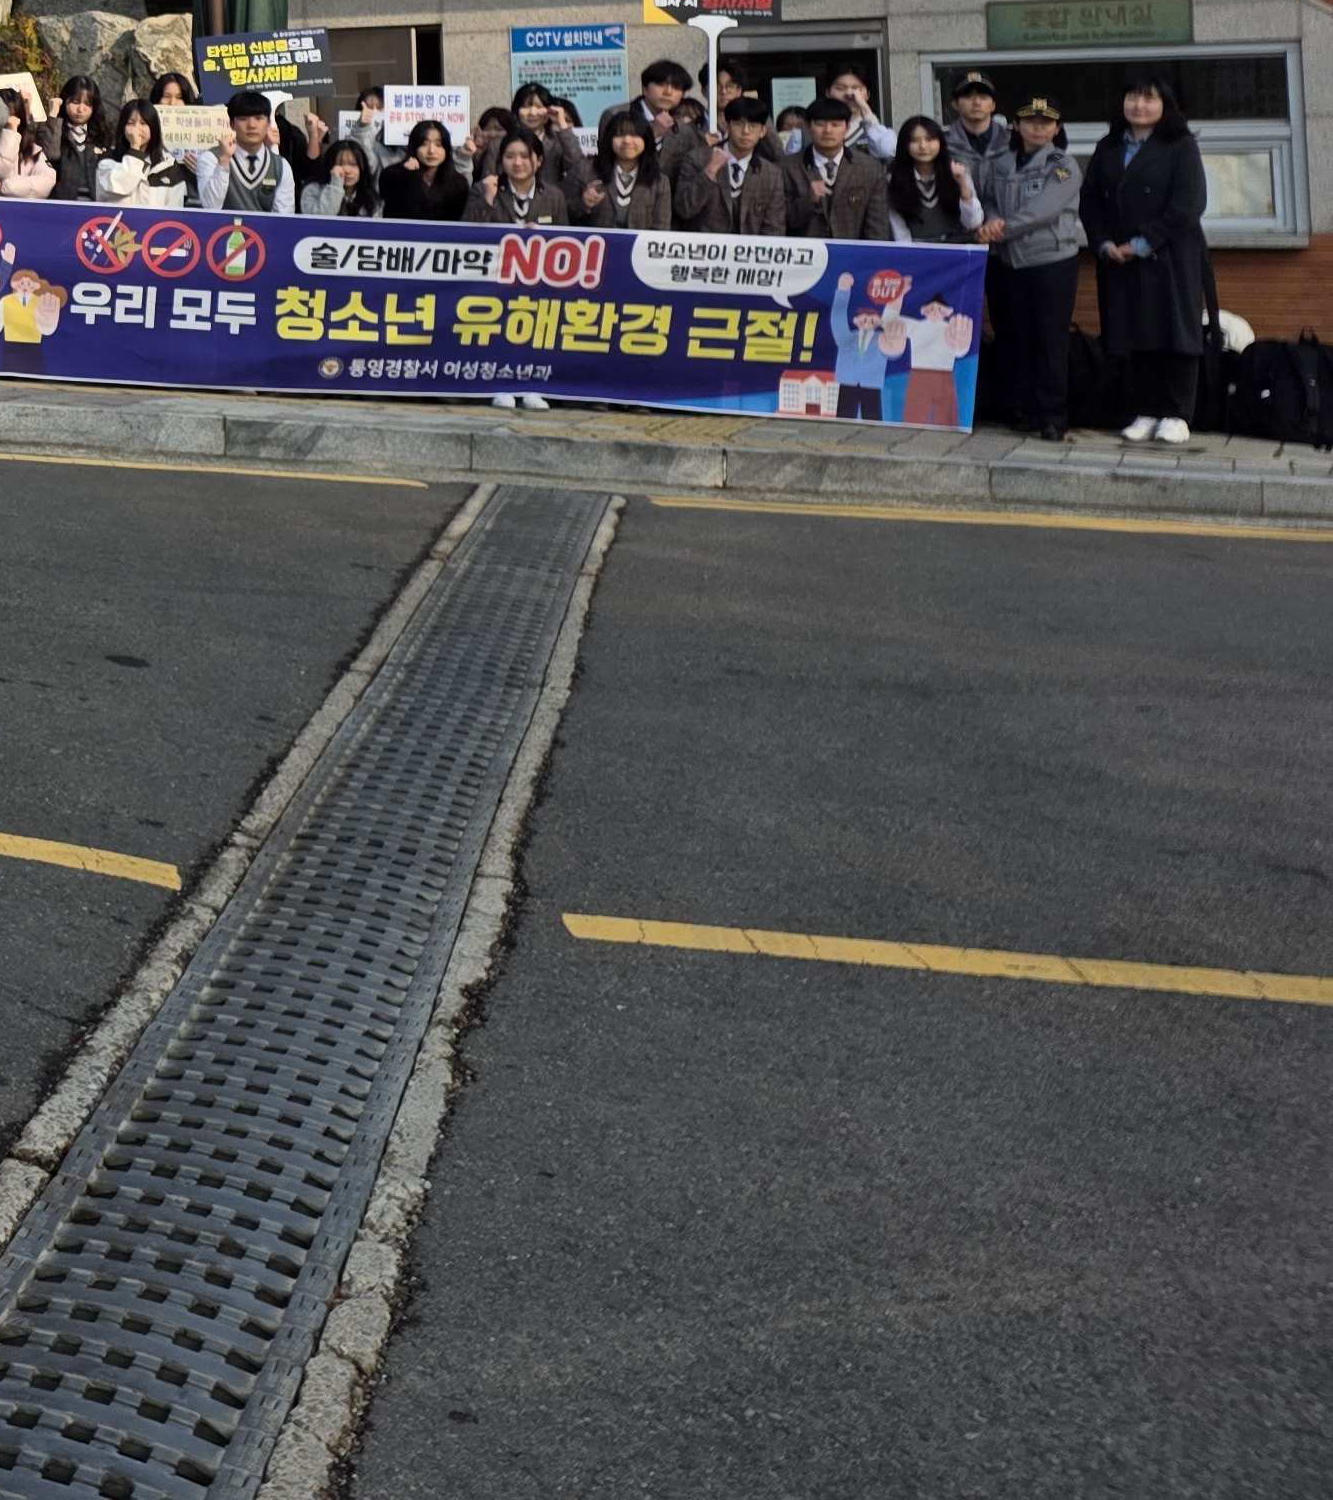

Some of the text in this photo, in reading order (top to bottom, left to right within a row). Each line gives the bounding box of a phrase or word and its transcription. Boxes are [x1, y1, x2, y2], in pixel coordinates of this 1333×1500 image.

[526, 31, 561, 47] CCTV
[206, 43, 246, 58] 타인의
[223, 56, 250, 70] 담배
[294, 49, 322, 64] 하면
[229, 64, 298, 86] 형사처벌
[393, 93, 461, 109] 불법촬영 OFF
[447, 112, 466, 123] NOW
[310, 237, 602, 286] 술/담배/마약 NO!
[647, 241, 815, 267] 청소년이 안전하고
[670, 265, 784, 288] 행복한 세상!
[871, 285, 900, 299] OUT
[70, 282, 819, 364] 우리 모두 청소년 유해환경 근절!
[348, 358, 553, 382] 통영경찰서 여성청소년과
